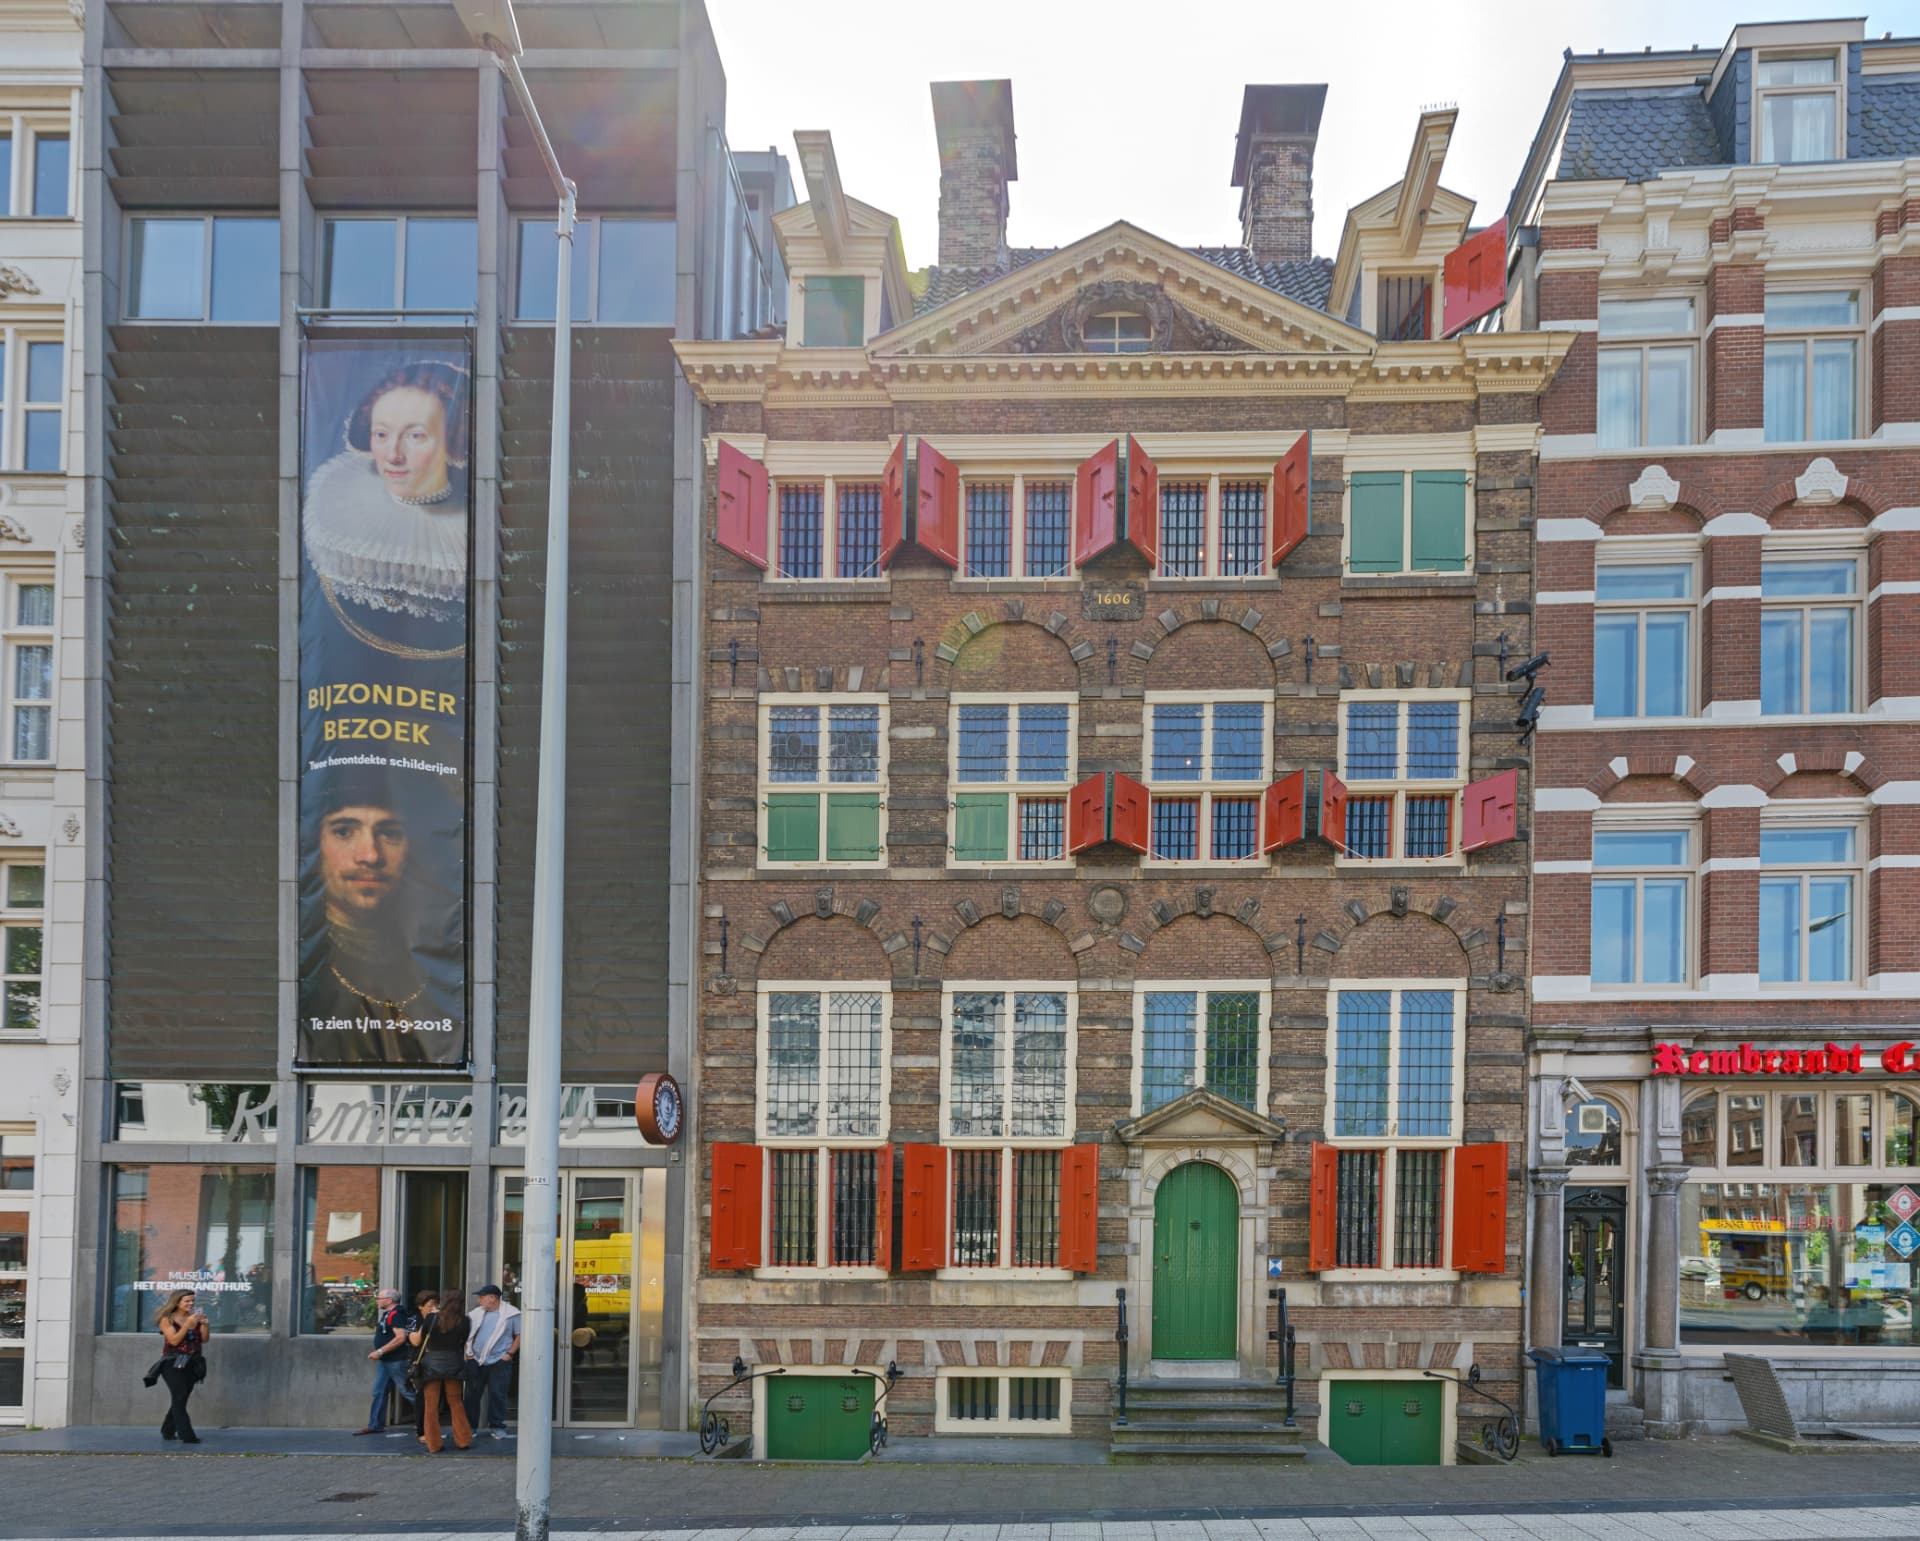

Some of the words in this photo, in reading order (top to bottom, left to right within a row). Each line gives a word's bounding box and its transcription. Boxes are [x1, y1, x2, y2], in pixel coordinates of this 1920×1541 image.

[1098, 593, 1130, 605] 1606
[308, 683, 456, 715] BIJZONDER
[324, 718, 431, 745] BEZOEK
[328, 754, 387, 766] herontdekte
[389, 758, 458, 775] schilderijen
[310, 1018, 324, 1030] Te
[325, 1016, 353, 1030] zien
[355, 1017, 382, 1033] t/m
[1653, 1041, 1866, 1075] Rembrandt
[168, 1271, 216, 1280] MUSEUM
[133, 1281, 155, 1290] HET
[156, 1281, 251, 1291] REMBRANDTHUIS
